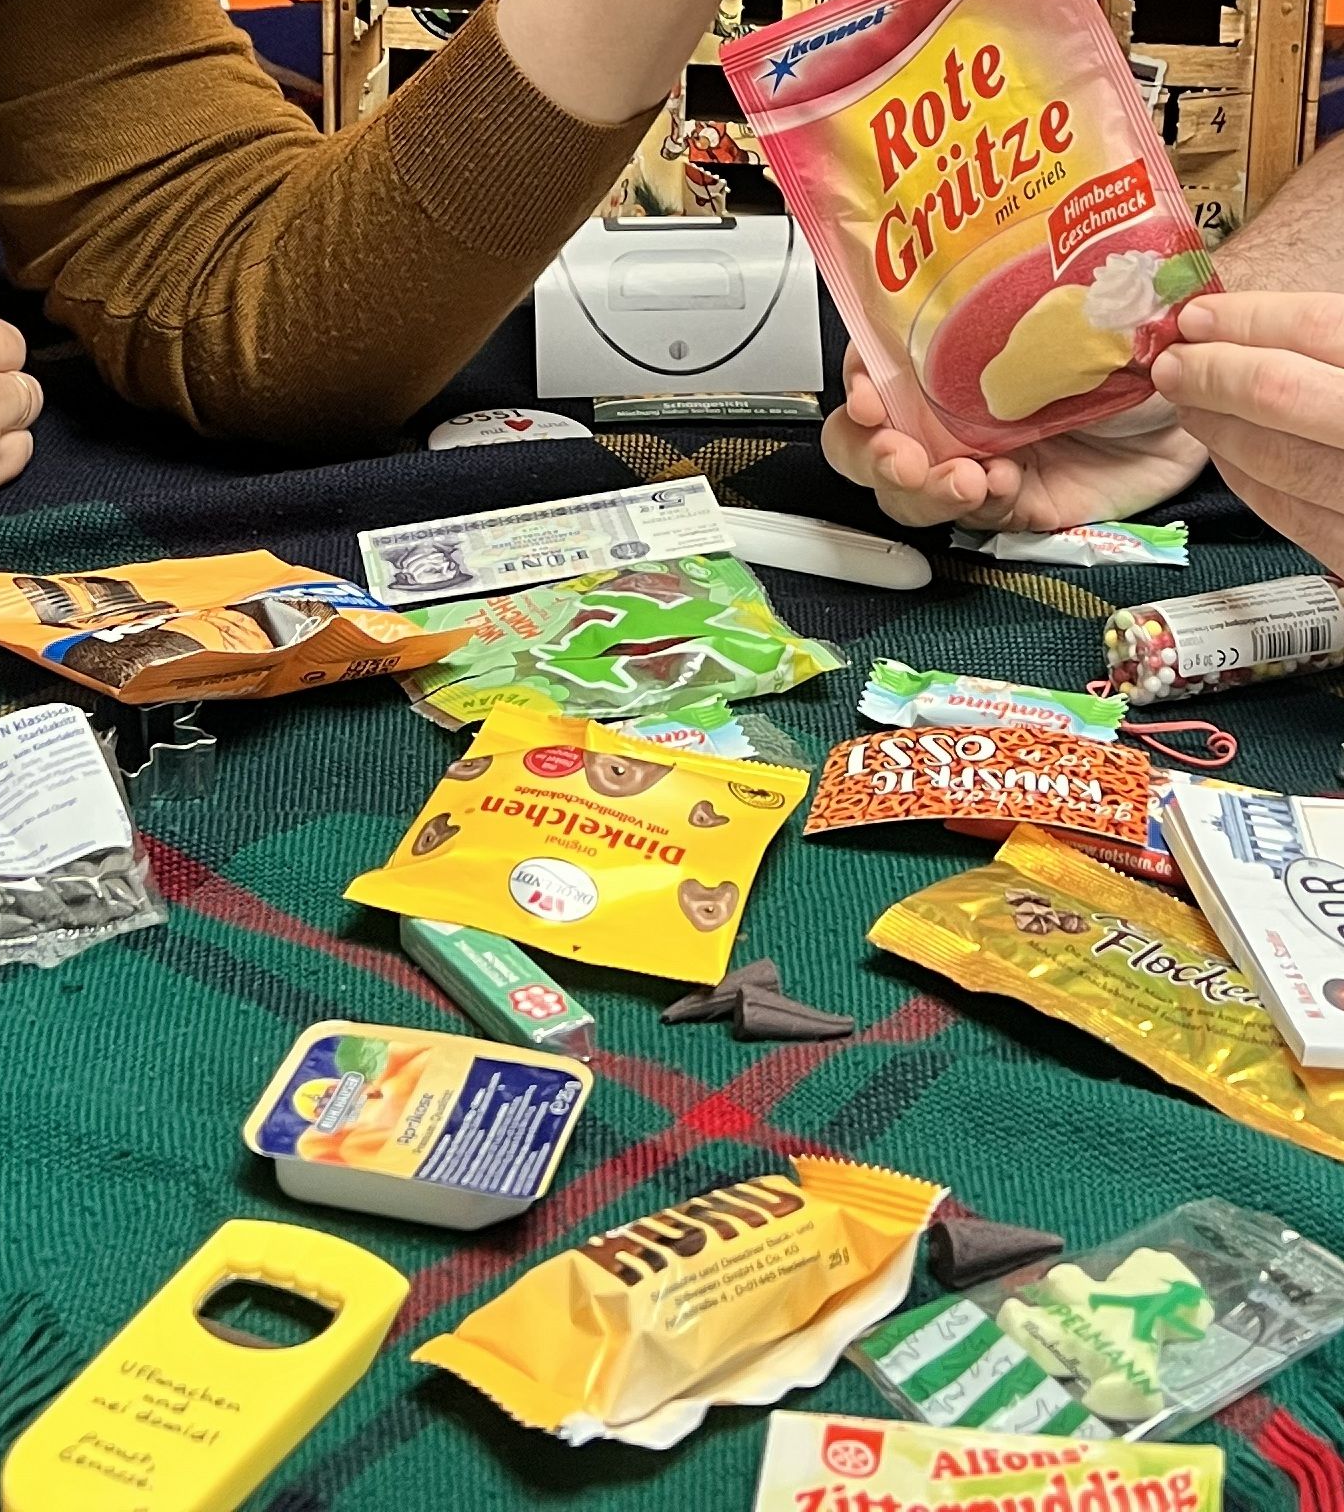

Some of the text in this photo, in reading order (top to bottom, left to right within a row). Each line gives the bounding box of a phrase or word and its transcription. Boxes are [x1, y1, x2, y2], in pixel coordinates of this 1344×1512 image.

[869, 43, 1007, 195] Rote
[1210, 105, 1227, 135] 4
[873, 100, 1075, 294] Grütze
[994, 161, 1068, 226] mit Grieß
[1063, 175, 1140, 224] Himbeer-
[1057, 190, 1148, 256] Geschmack
[947, 694, 1072, 728] bambina
[843, 733, 998, 778] OSSI
[514, 785, 638, 829] Vollmilchschokolade
[870, 765, 1103, 804] KNUSPRIG
[480, 796, 688, 868] Dinkelchen
[544, 835, 599, 858] Original
[576, 1177, 806, 1287] HUND
[930, 1443, 1090, 1481] Alfons'
